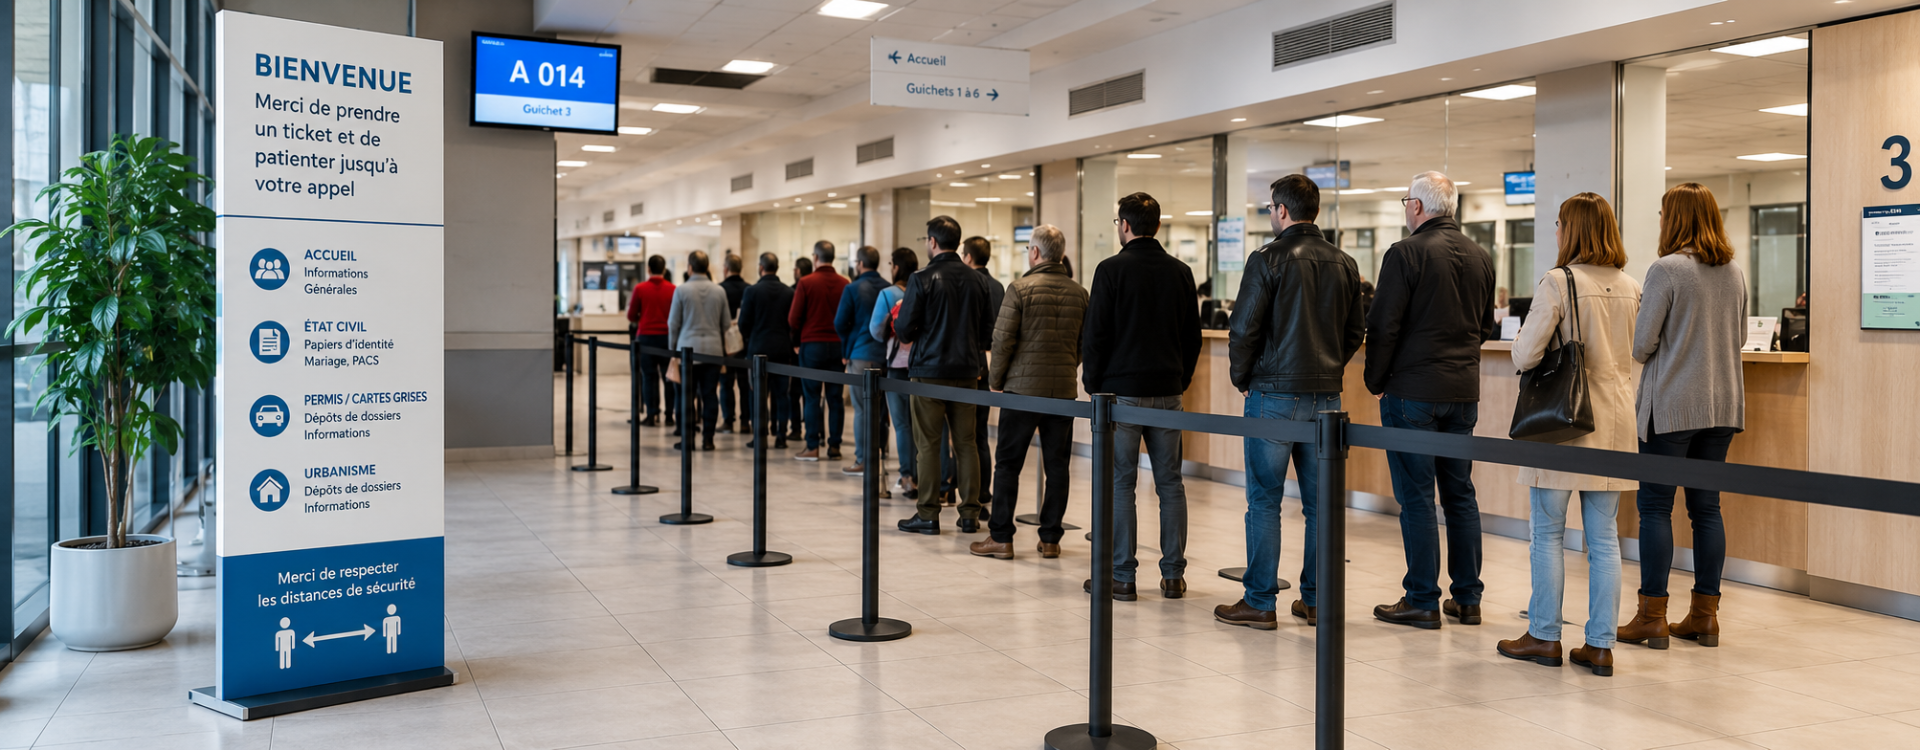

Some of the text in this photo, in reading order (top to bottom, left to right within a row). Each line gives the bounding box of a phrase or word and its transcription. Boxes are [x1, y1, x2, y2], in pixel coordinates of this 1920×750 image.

[907, 53, 946, 66] Accueil
[255, 53, 413, 94] BIENVENUE
[509, 60, 585, 89] A 014
[906, 83, 980, 99] Guichets 1 à 6
[255, 93, 400, 123] Merci de prendre
[523, 104, 572, 117] Guichet 3
[255, 123, 381, 147] un ticket et de
[255, 150, 398, 177] patienter jusqu’à
[1880, 135, 1912, 189] 3
[255, 178, 355, 200] votre appel
[304, 249, 357, 261] ACCUEIL
[304, 267, 369, 279] Informations
[304, 283, 358, 295] Générales
[304, 319, 367, 332] ÉTAT CIVIL
[304, 339, 394, 352] Papiers d'identité
[304, 355, 379, 369] Mariage, PACS
[304, 393, 343, 406] PERMIS
[352, 392, 391, 404] CARTES
[393, 391, 428, 403] GRISES
[304, 410, 401, 425] Dépôts de dossiers
[304, 428, 371, 440] Informations
[304, 464, 376, 479] URBANISME
[304, 481, 402, 498] Dépôts de dossiers
[304, 500, 371, 514] Informations
[278, 562, 399, 585] Merci de respecter
[258, 577, 416, 608] les distances de sécurité
